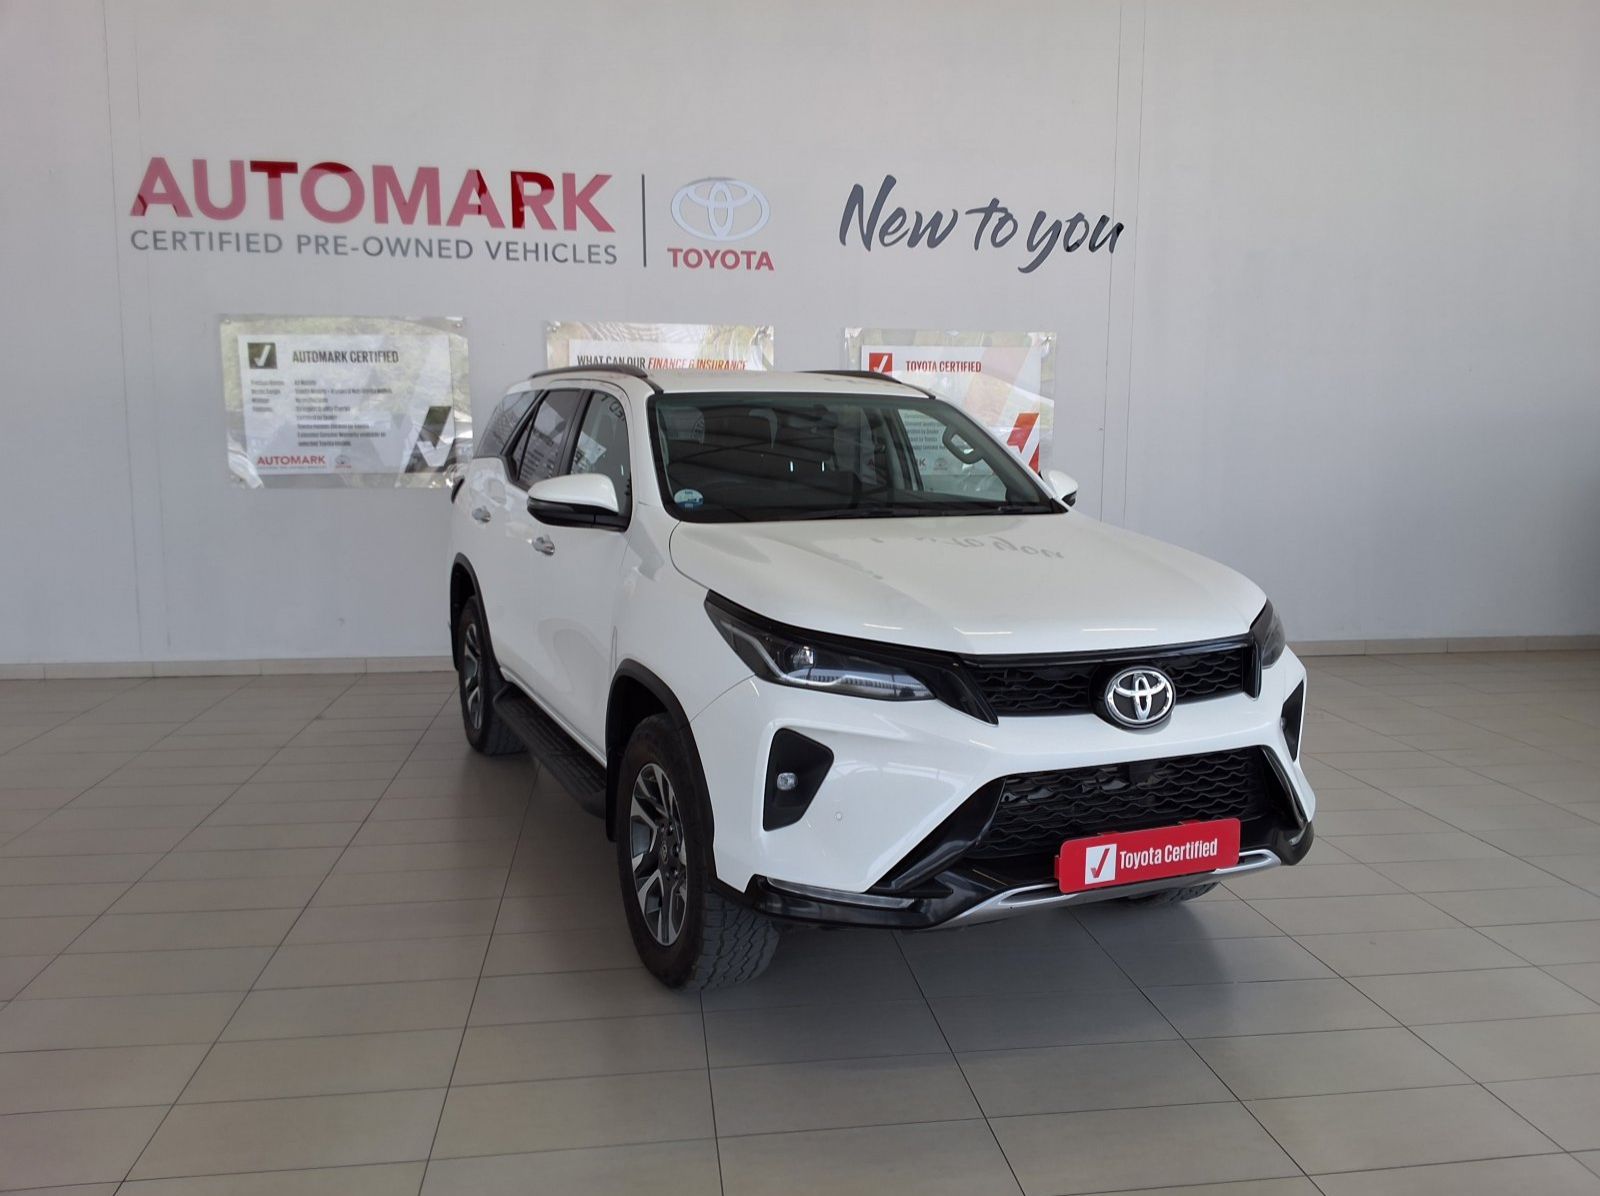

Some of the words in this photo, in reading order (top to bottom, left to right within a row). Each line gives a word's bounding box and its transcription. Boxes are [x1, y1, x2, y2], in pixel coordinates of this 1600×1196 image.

[129, 156, 616, 233] AUTOMARK
[838, 174, 958, 252] New
[965, 197, 1018, 251] to
[1017, 211, 1125, 274] you
[130, 229, 284, 254] CERTIFIED
[296, 233, 474, 261] PRE-OWNED
[485, 240, 618, 266] VEHICLES
[667, 247, 775, 272] TOYOTA
[292, 350, 348, 364] AUTOMARK
[350, 350, 399, 364] CERTIFIED
[577, 355, 604, 367] WHAT
[605, 356, 626, 367] CAN
[627, 356, 646, 369] OUR
[647, 356, 687, 369] FINANCE
[696, 358, 748, 370] INSURANCE
[906, 360, 938, 372] TOYOTA
[939, 360, 982, 373] CERTIFIED
[257, 454, 326, 465] AUTOMARK
[1119, 846, 1162, 870] Toyota
[1164, 838, 1218, 863] Certified
